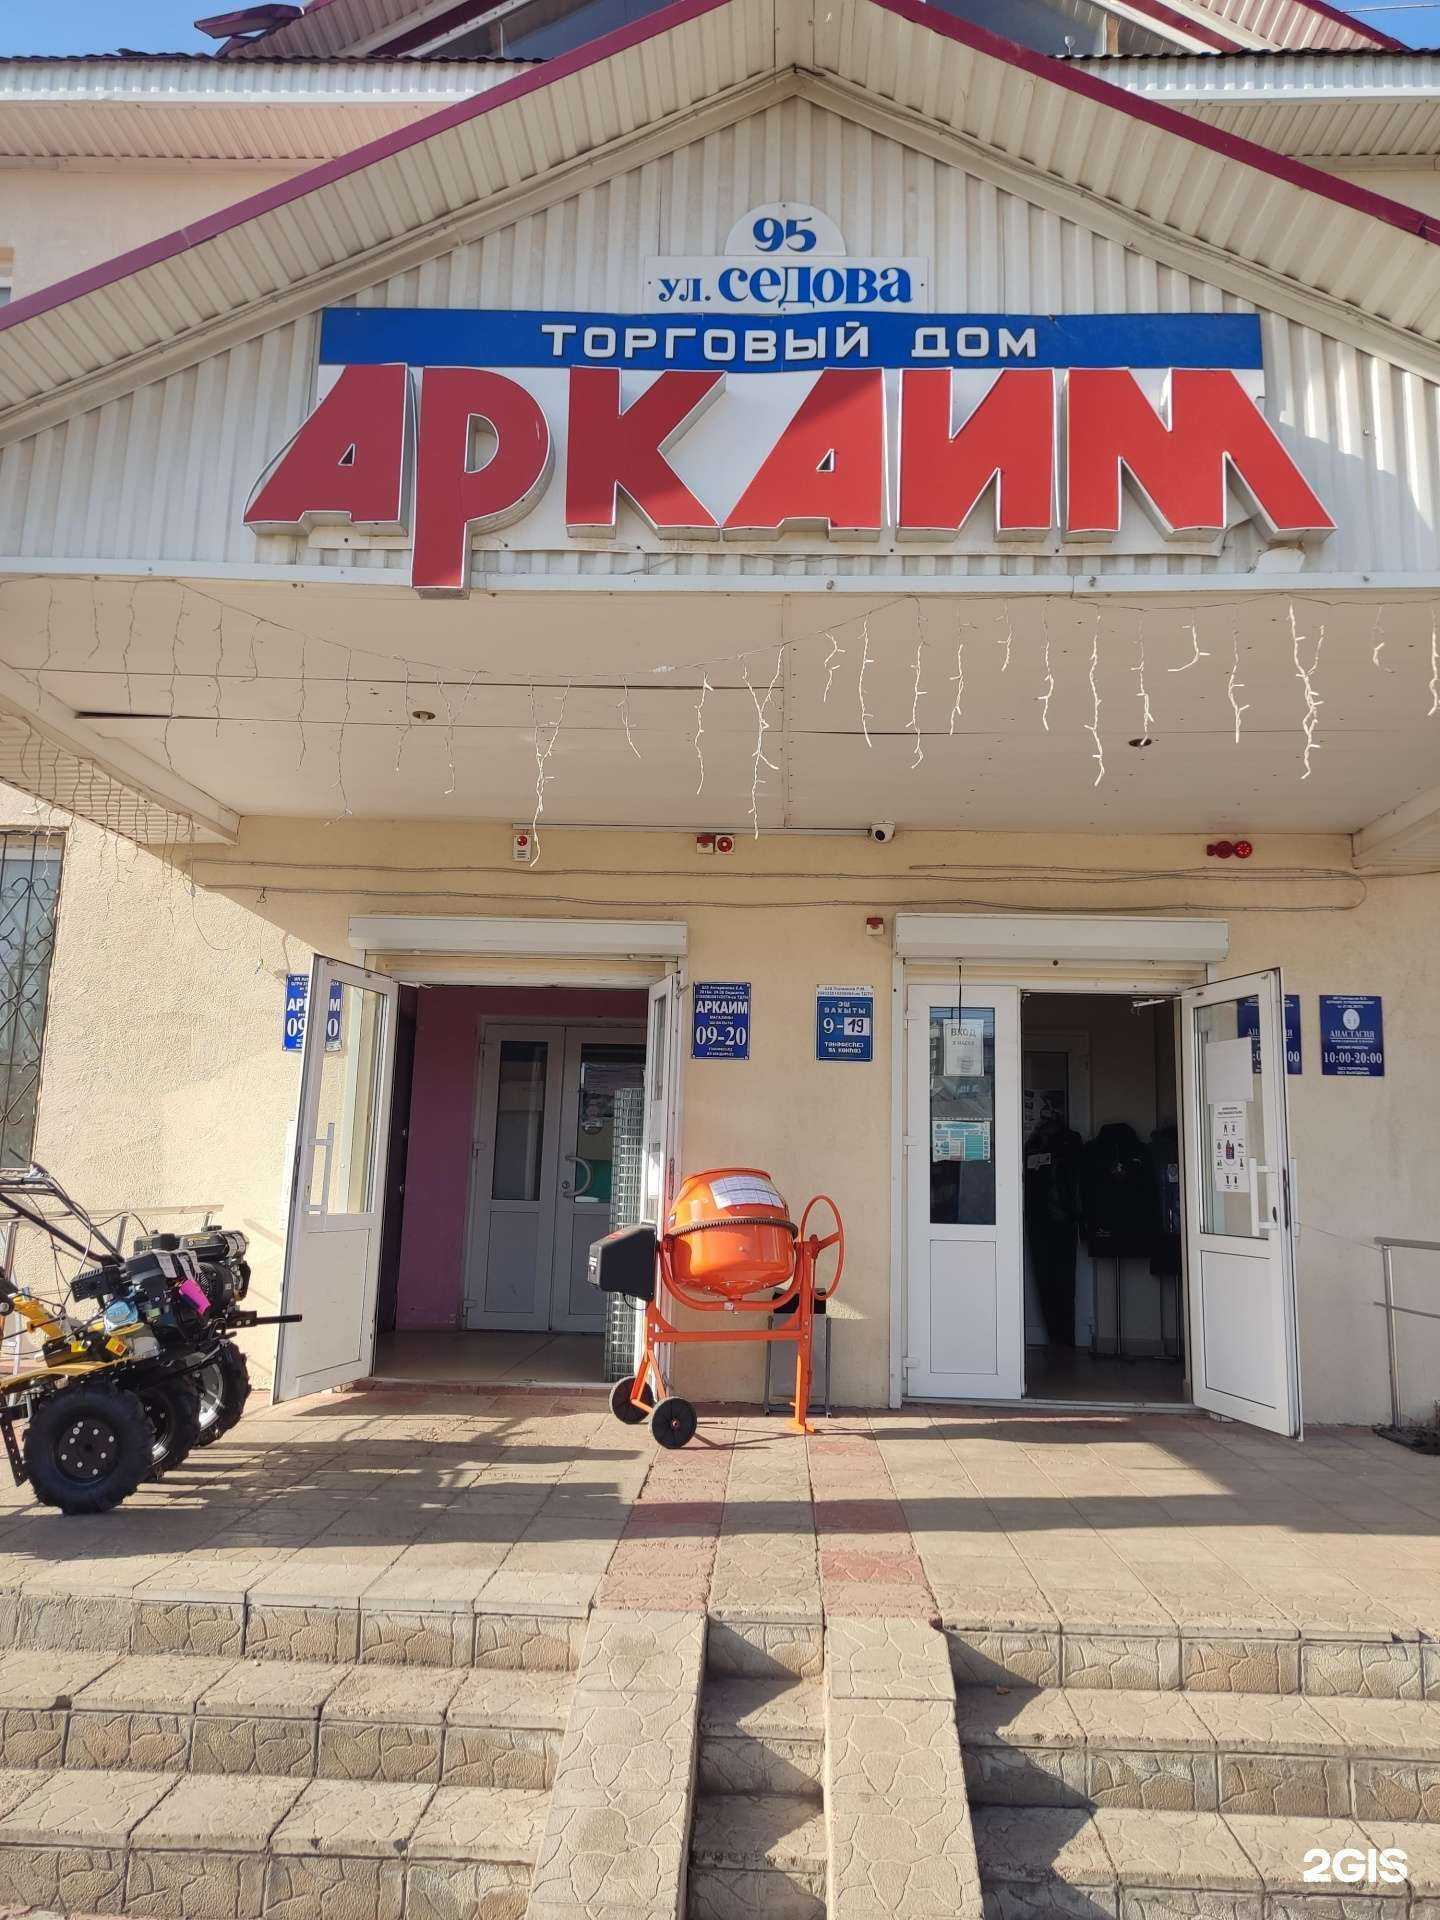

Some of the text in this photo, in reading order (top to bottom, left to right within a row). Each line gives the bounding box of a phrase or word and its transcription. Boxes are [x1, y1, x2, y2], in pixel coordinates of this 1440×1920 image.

[753, 217, 816, 252] 95
[658, 278, 711, 302] ул.
[541, 320, 1036, 362] ТОРГОВЫЙ ДОМ
[243, 362, 1337, 600] АРКАИМ
[696, 1001, 748, 1014] АРКАИМ
[696, 1026, 746, 1045] 09-20
[1324, 1051, 1382, 1064] 10:00-20:00
